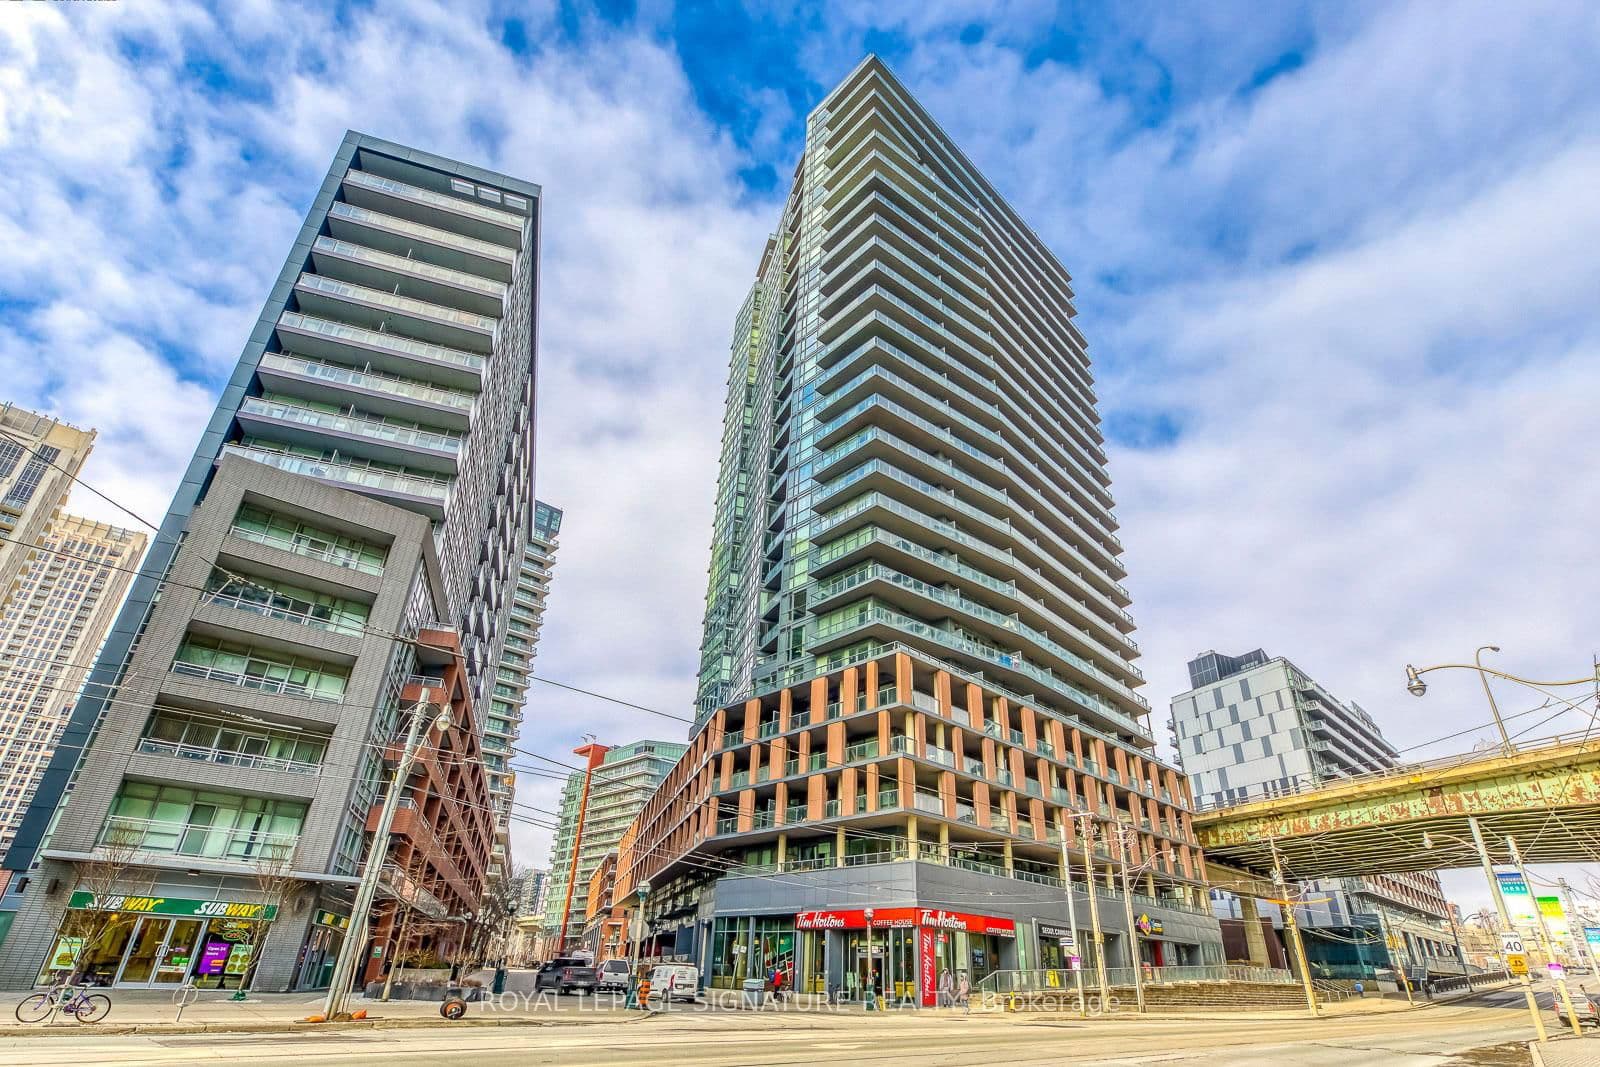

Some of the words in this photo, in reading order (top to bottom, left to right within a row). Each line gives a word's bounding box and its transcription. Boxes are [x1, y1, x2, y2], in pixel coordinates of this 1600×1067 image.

[85, 894, 164, 911] SUBWAY
[194, 902, 262, 917] SUBWAY
[796, 913, 812, 928] Tim
[811, 912, 845, 928] Hortons
[921, 909, 938, 928] Tim
[937, 911, 967, 930] Hortons
[923, 933, 932, 954] Tim
[1505, 941, 1522, 951] 40
[923, 956, 932, 998] Hortons
